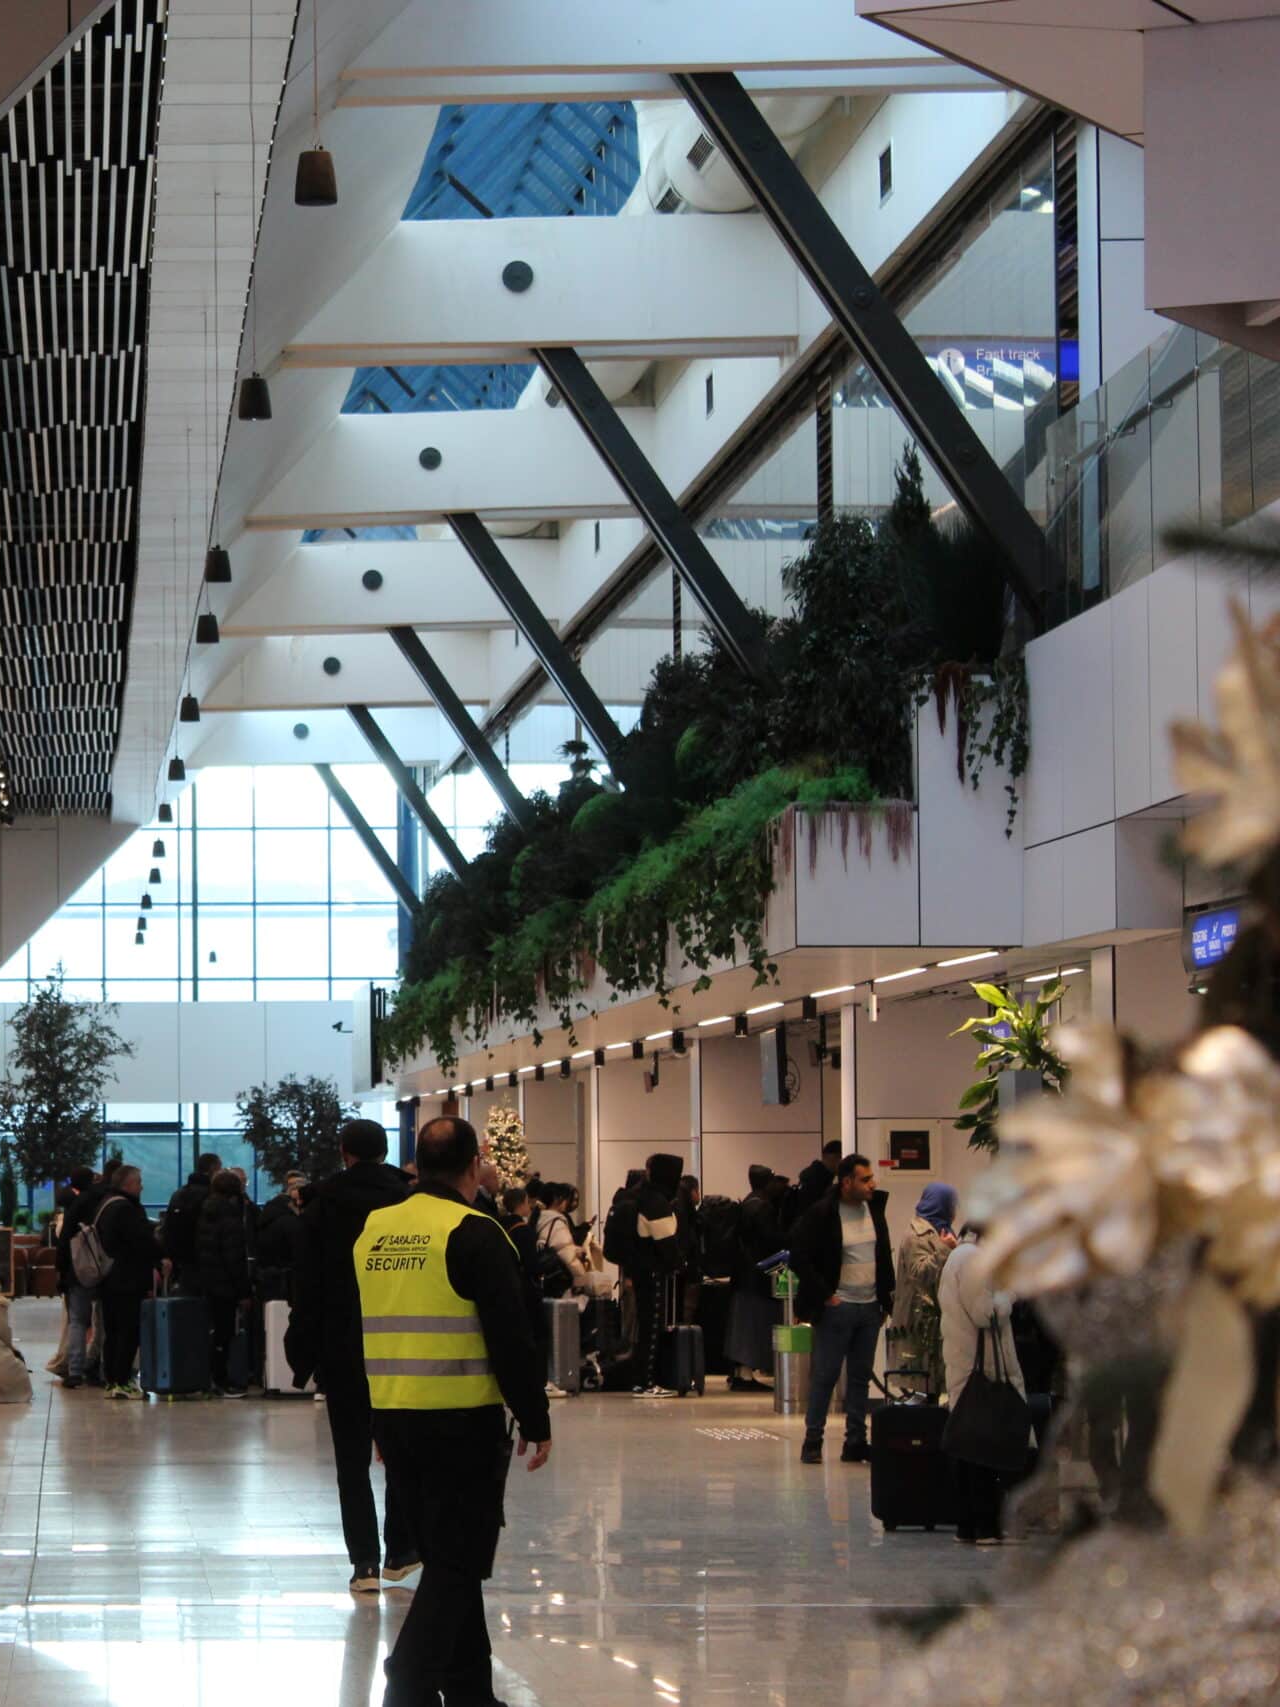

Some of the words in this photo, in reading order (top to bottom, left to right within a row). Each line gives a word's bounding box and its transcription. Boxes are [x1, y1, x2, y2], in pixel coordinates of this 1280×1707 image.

[976, 348, 1005, 361] Fast
[1008, 348, 1041, 361] track
[365, 1256, 427, 1272] SECURITY
